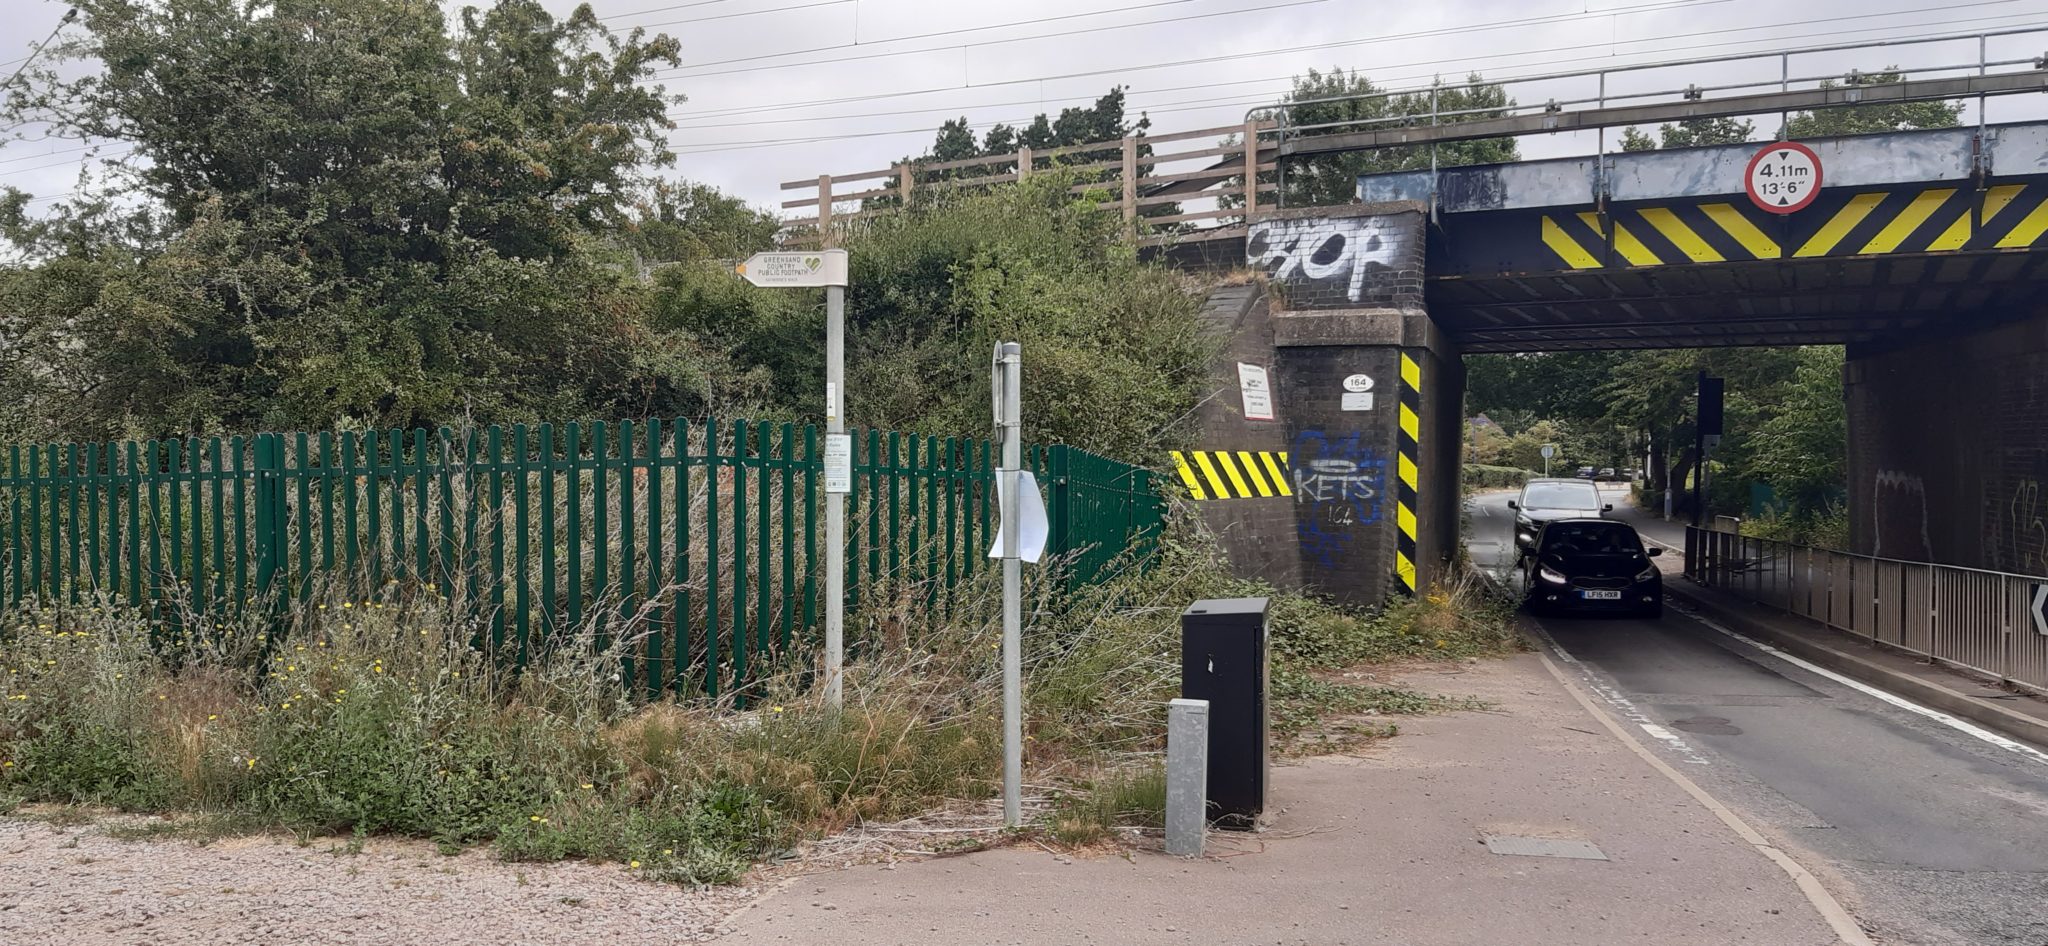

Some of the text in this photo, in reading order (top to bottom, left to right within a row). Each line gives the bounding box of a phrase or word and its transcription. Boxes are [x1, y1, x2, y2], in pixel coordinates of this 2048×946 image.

[1759, 163, 1808, 178] 4.11m
[758, 268, 808, 276] PUBLIC FOOTPATH
[1350, 378, 1367, 387] 164
[1294, 468, 1375, 503] KETS
